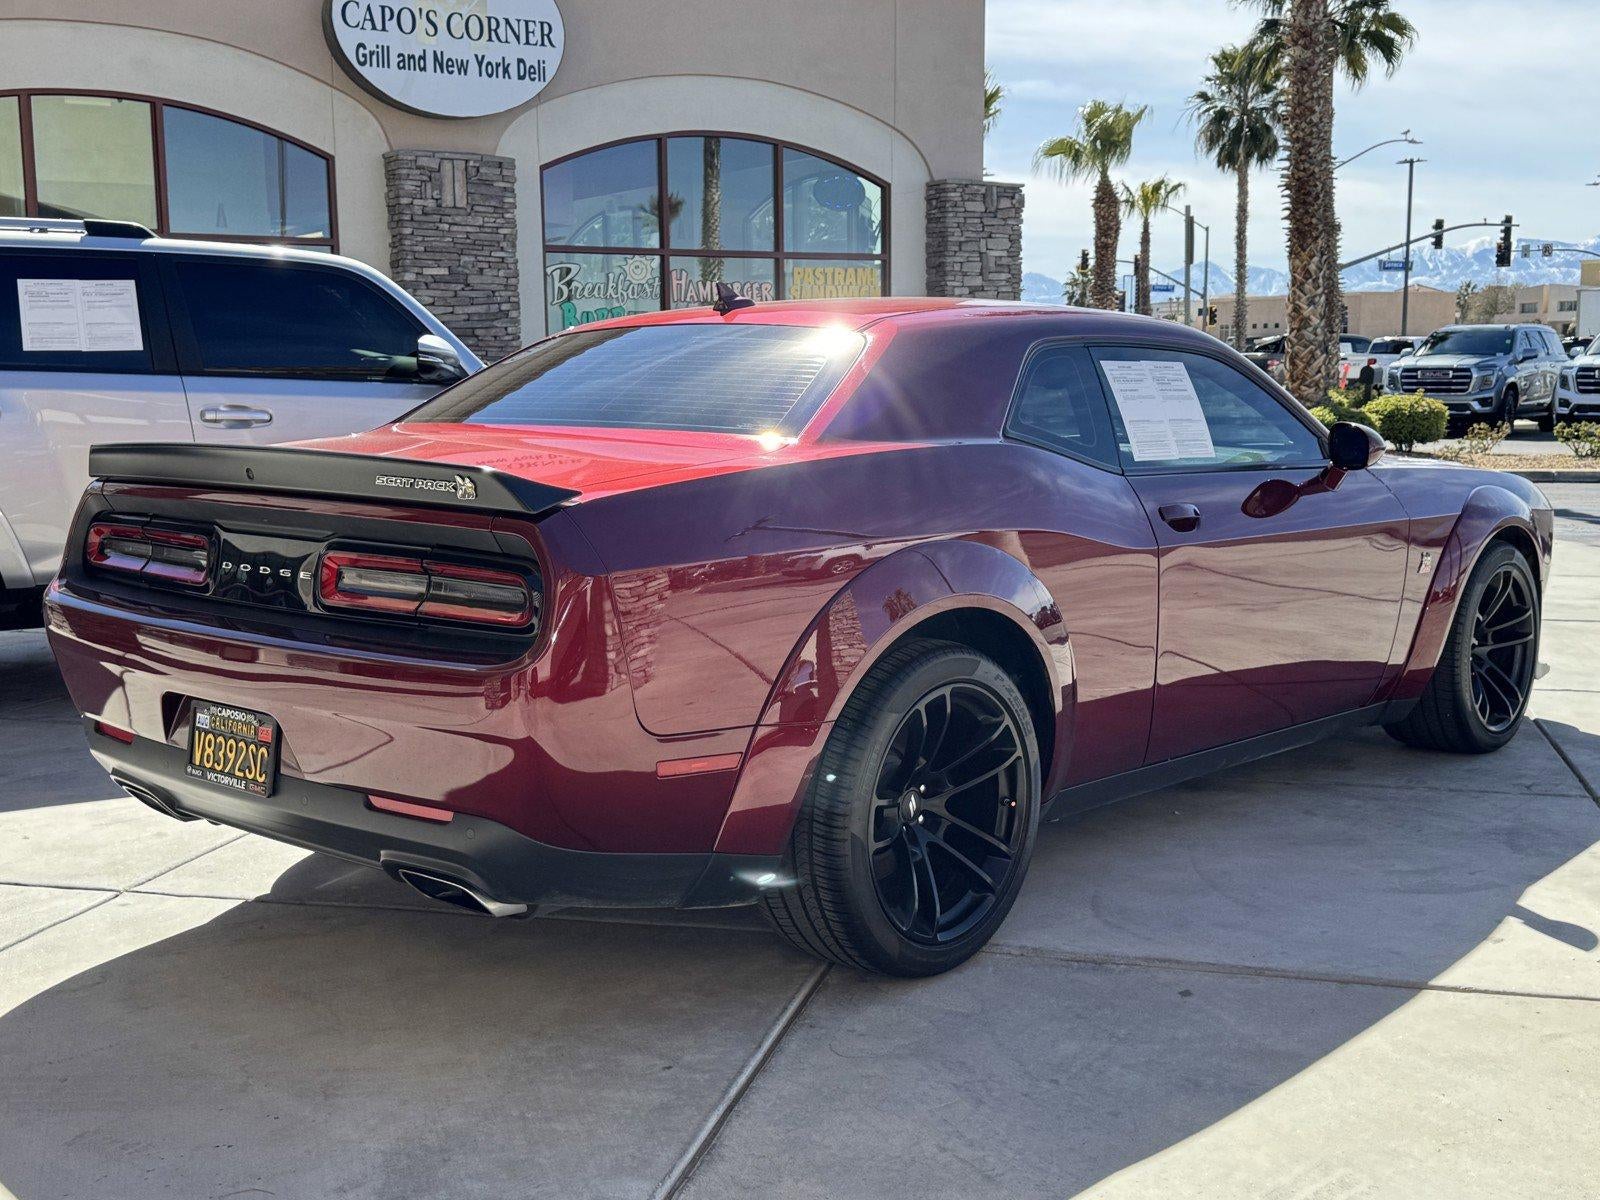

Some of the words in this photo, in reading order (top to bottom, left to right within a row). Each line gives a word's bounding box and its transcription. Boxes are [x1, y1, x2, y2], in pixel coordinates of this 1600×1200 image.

[341, 0, 439, 37] CAPO'S
[446, 12, 556, 48] CORNER
[355, 42, 391, 69] Grill
[396, 49, 427, 72] and
[433, 50, 469, 76] New
[474, 54, 512, 80] York
[517, 58, 546, 82] Deli
[546, 262, 660, 306] Breakfast
[375, 475, 414, 488] SCAT
[415, 478, 455, 492] PACK
[221, 561, 312, 580] DODGE
[217, 707, 246, 721] CAPOSIO
[211, 716, 255, 736] CALIFORNIA
[194, 730, 269, 783] V8392SC
[206, 771, 247, 789] VICTORVILLE
